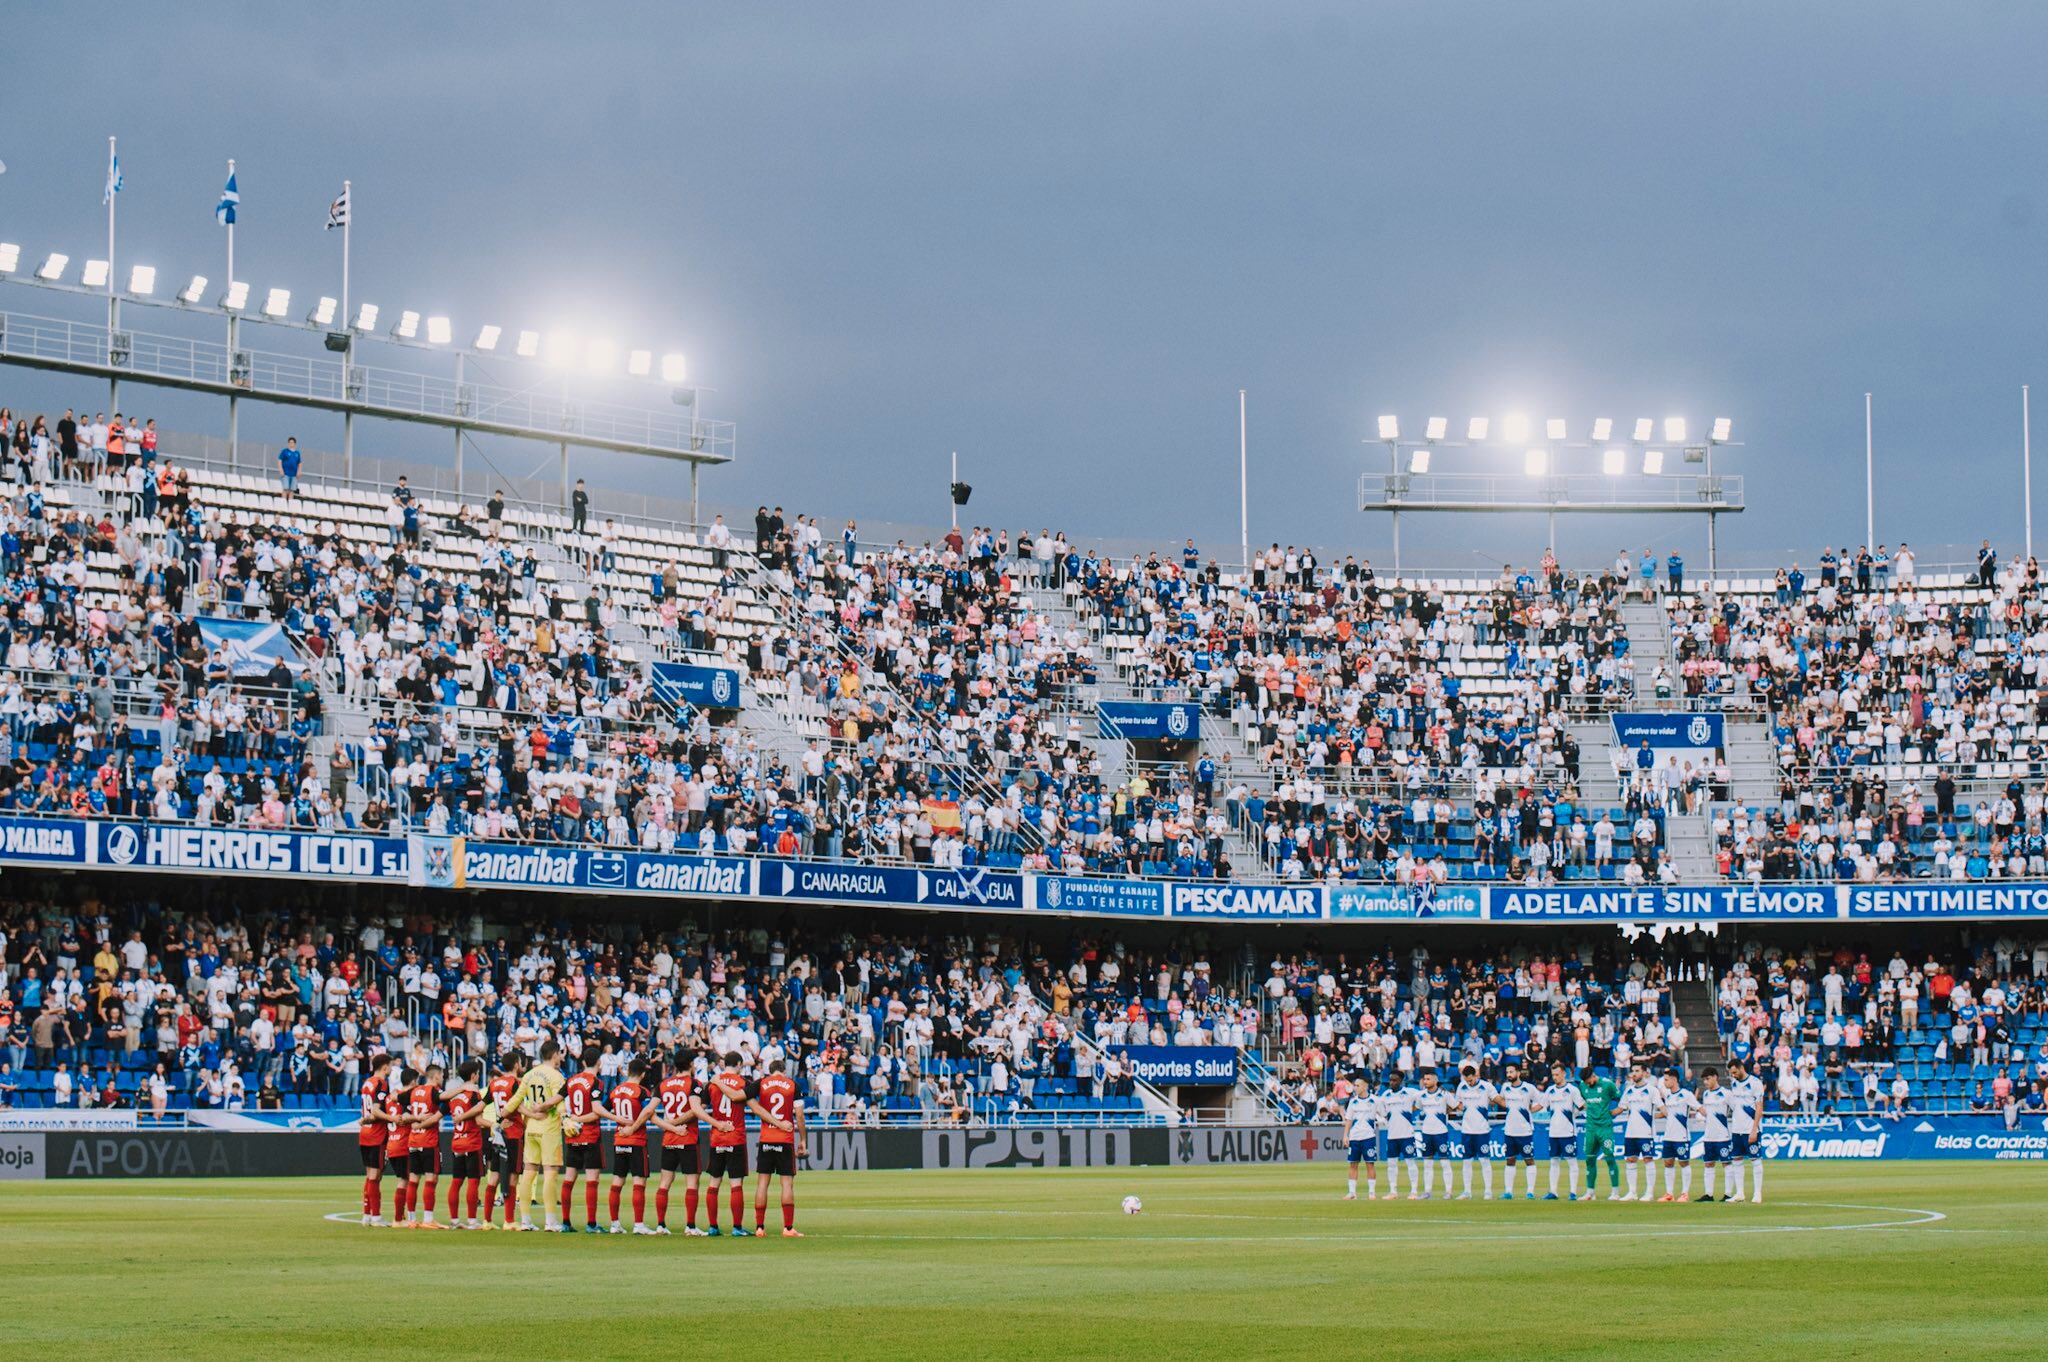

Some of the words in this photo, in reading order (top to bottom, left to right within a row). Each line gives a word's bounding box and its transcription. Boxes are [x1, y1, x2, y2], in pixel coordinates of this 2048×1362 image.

[6, 827, 75, 856] MARCA
[146, 828, 291, 871] HIERROS
[300, 836, 374, 875] ICOD
[465, 847, 578, 884] canaribat
[636, 858, 745, 893] canaribat
[802, 872, 886, 894] CANARAGUA
[936, 879, 1015, 901] CAGUA
[1066, 883, 1114, 894] FUNDACIÓN
[1120, 886, 1158, 896] CANARIA
[1091, 896, 1158, 910] TENERIFE
[1175, 888, 1316, 914] PESCAMAR
[1339, 893, 1475, 912] #VamosTerife
[1503, 893, 1655, 914] ADELANTE
[1664, 892, 1711, 913] SIN
[1722, 892, 1825, 913] TEMOR
[1855, 889, 2048, 912] SENTIMIENTO
[1133, 1060, 1192, 1081] Deportes
[1195, 1059, 1233, 1077] Salud
[573, 1090, 584, 1116] 9
[613, 1098, 633, 1121] 10
[662, 1091, 688, 1120] 22
[718, 1094, 732, 1118] 4
[769, 1092, 785, 1120] 2
[921, 1129, 1131, 1168] 02910
[1206, 1130, 1288, 1163] LALIGA
[1787, 1132, 1886, 1158] hummel
[1935, 1134, 1972, 1149] Islas
[66, 1139, 196, 1175] APOYA
[206, 1139, 231, 1175] A
